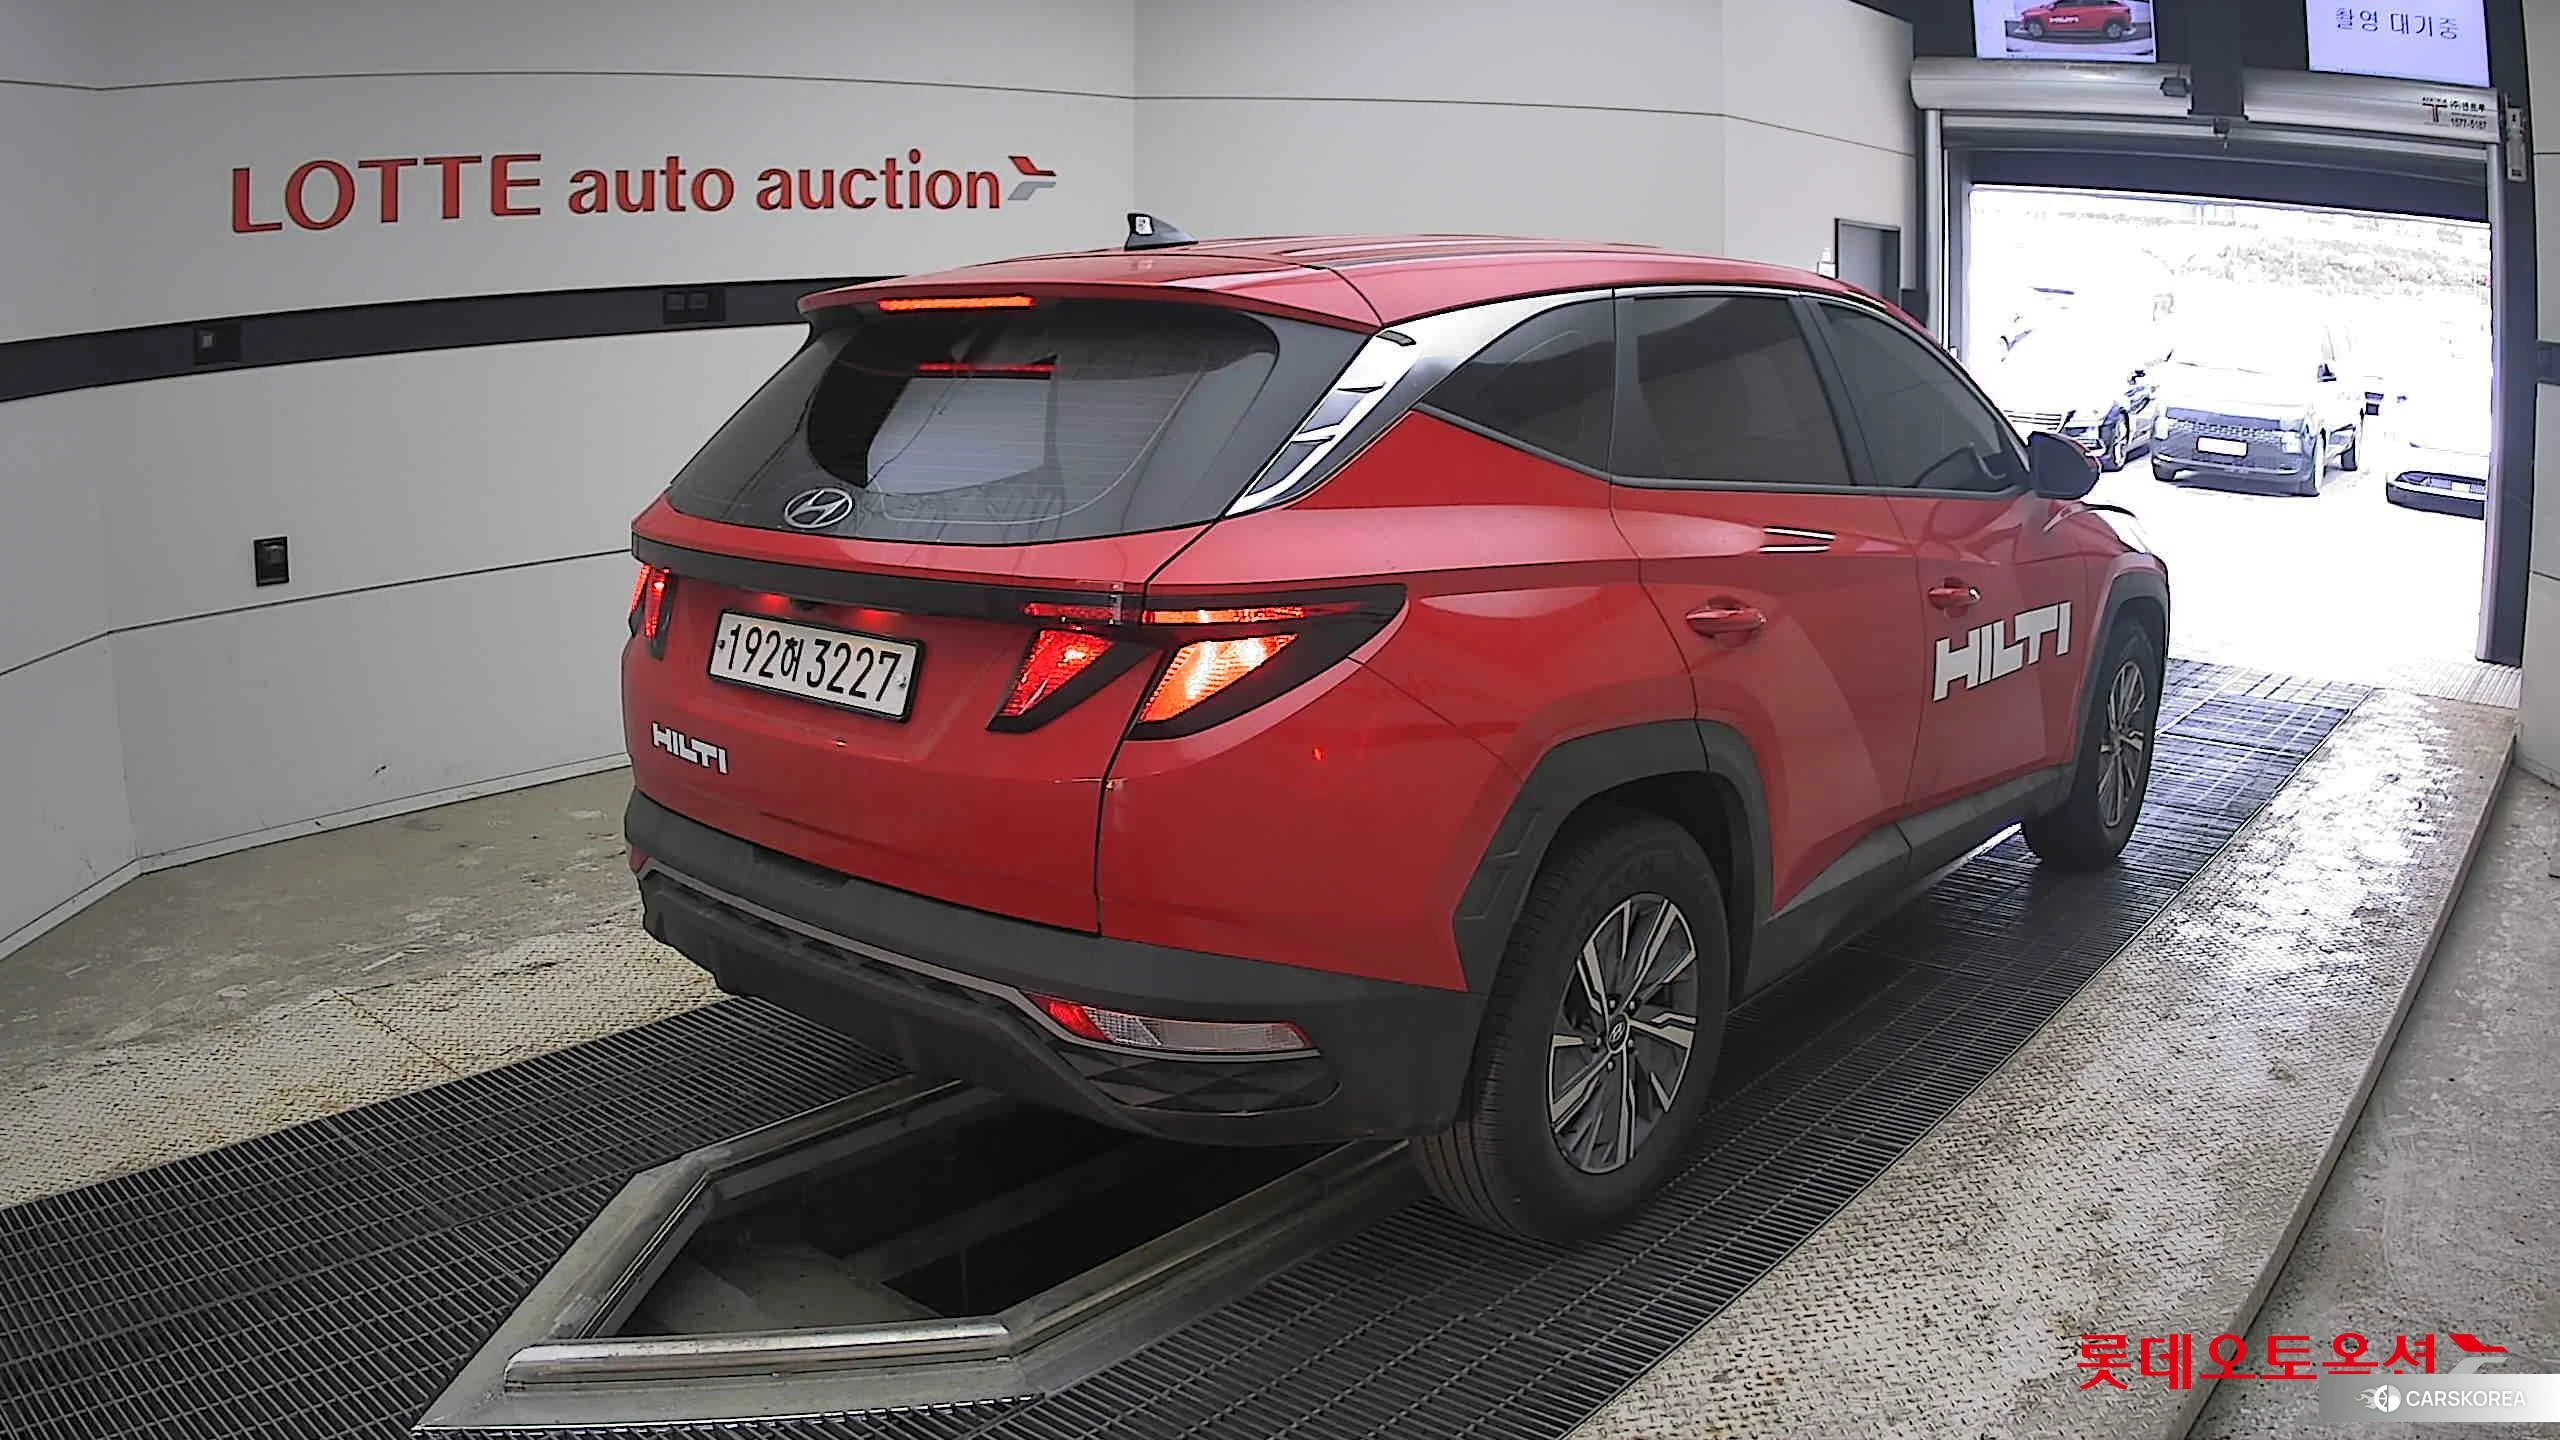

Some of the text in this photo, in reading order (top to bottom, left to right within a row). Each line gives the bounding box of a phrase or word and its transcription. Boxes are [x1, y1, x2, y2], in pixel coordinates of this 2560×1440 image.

[2335, 7, 2379, 32] 촬영
[232, 148, 1001, 233] LOTTE auto auction
[1931, 600, 2073, 703] HILTI
[651, 721, 729, 775] HILTI
